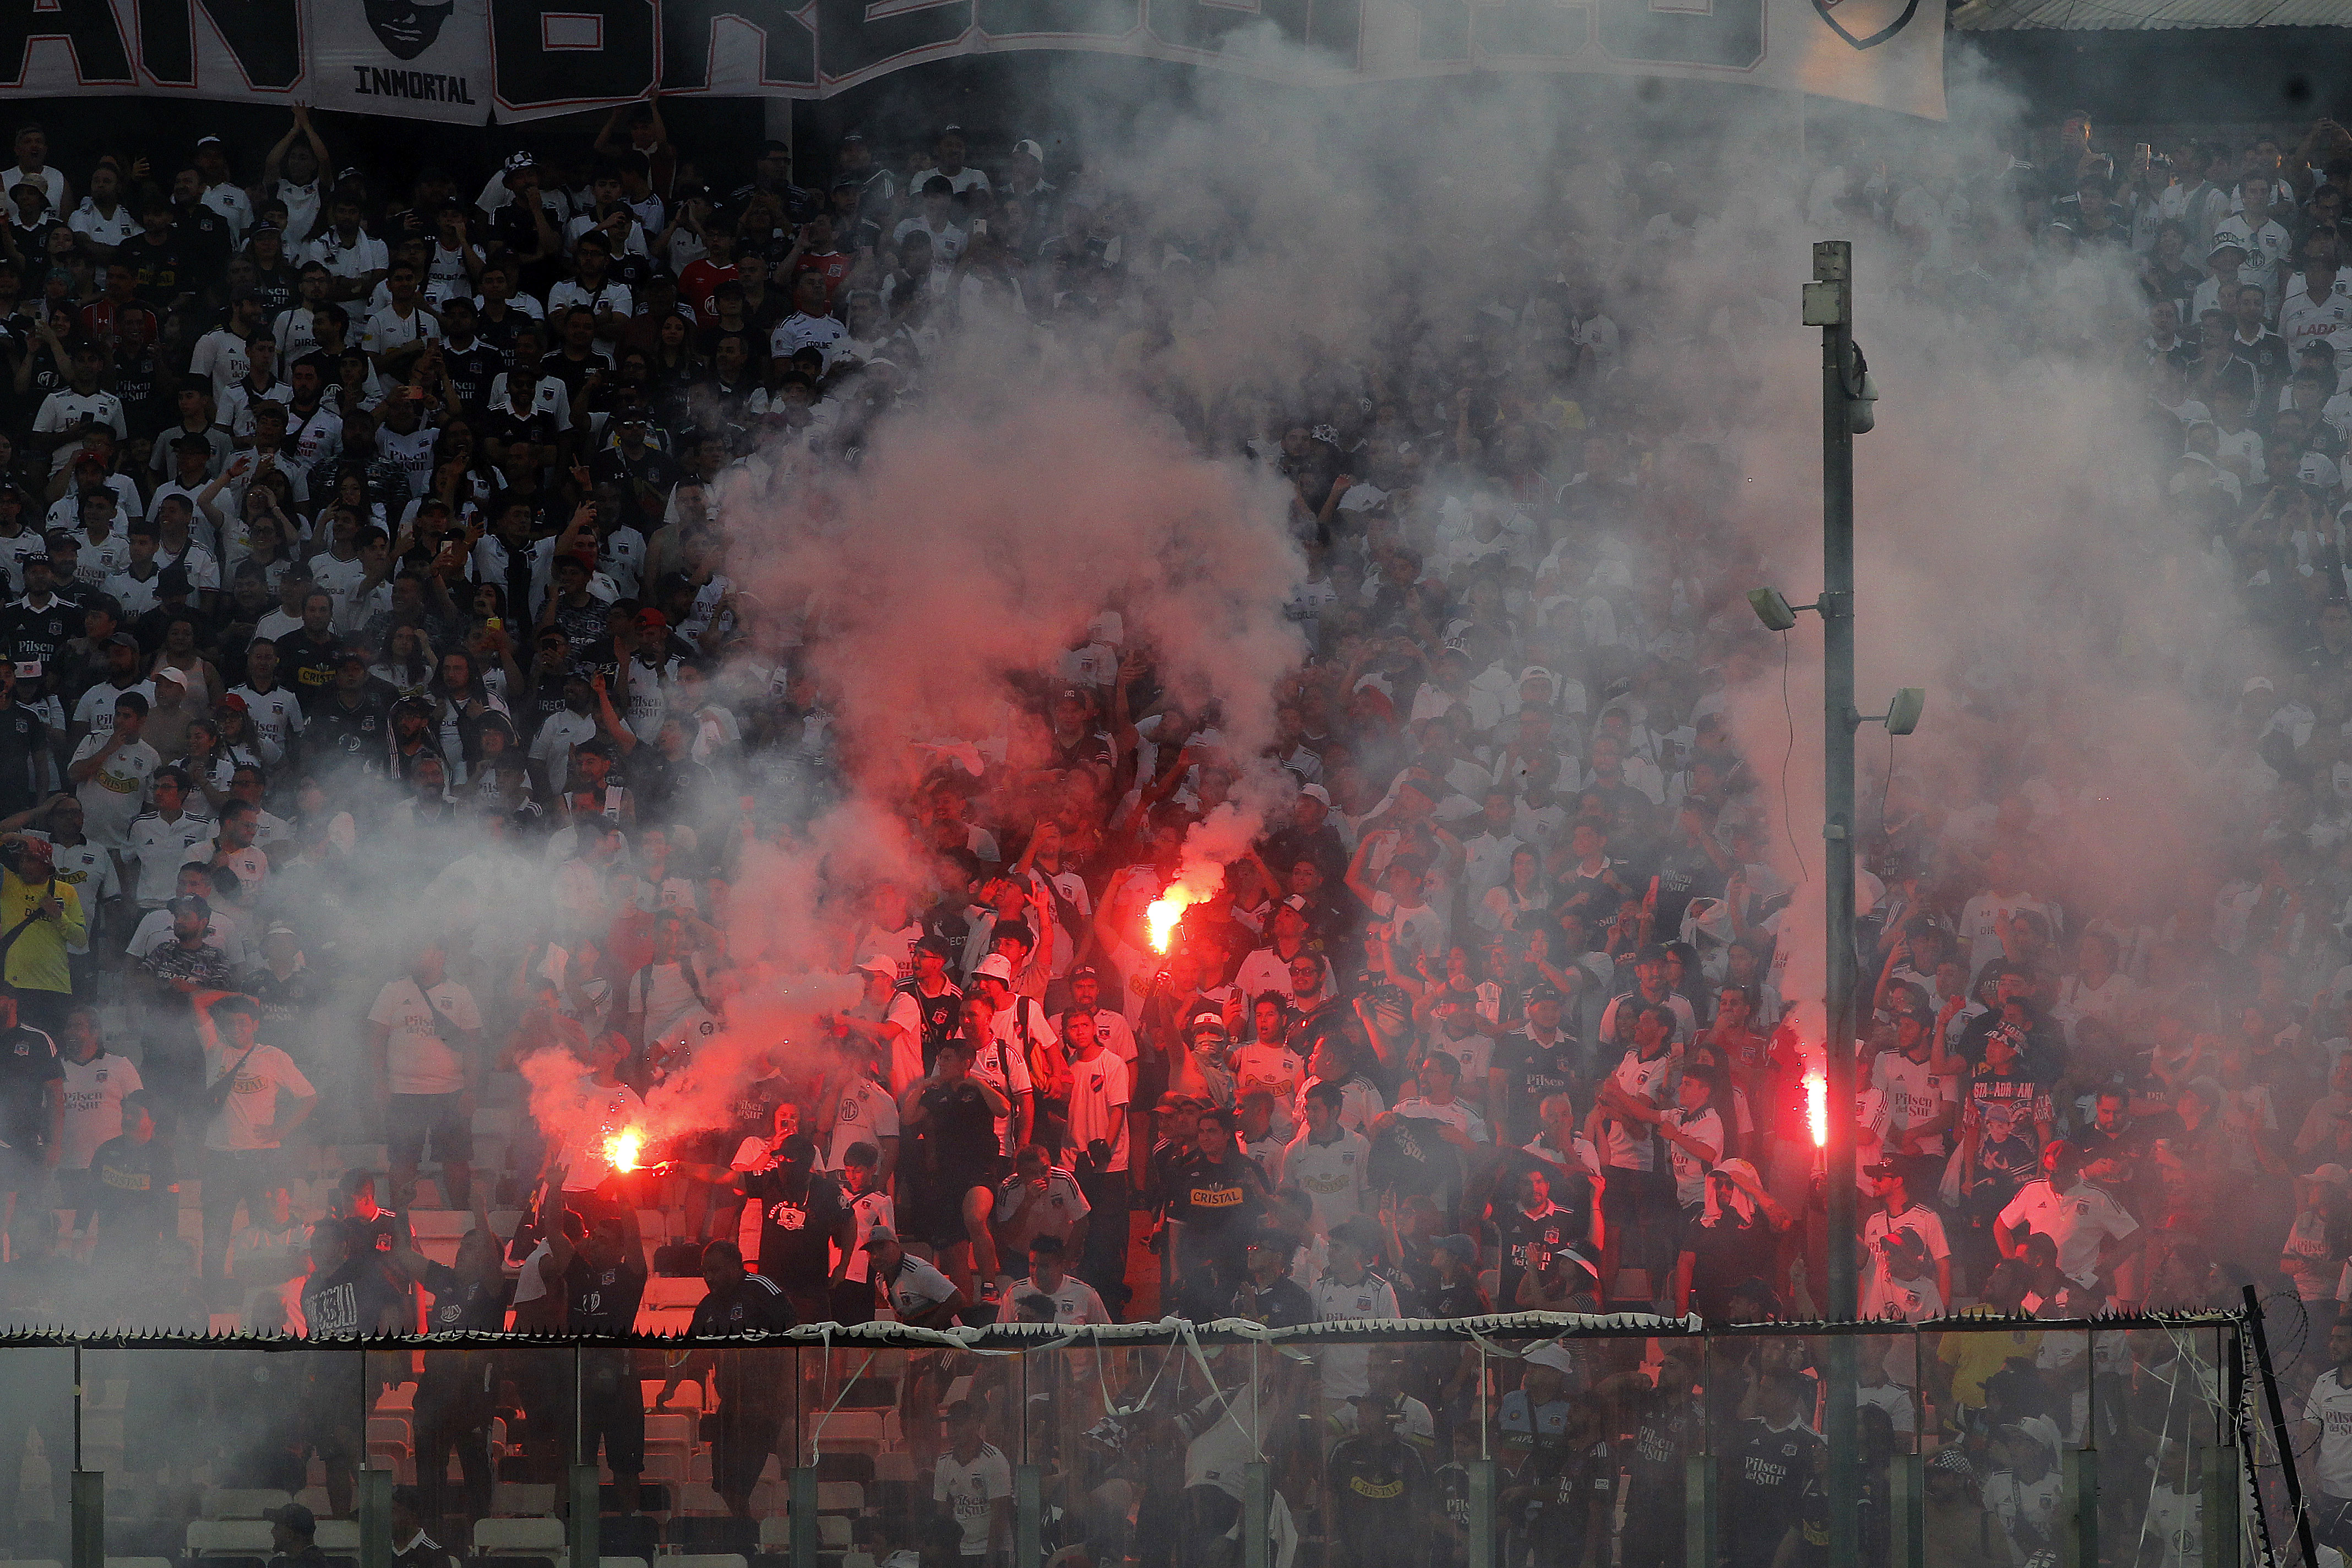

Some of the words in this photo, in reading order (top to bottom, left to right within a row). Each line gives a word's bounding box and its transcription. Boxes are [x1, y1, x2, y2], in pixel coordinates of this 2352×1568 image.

[354, 65, 476, 105] INMORTAL
[2296, 324, 2336, 336] LADA
[19, 640, 55, 653] Pilsen
[96, 714, 112, 724] Pil
[1527, 1075, 1564, 1086] Pilsen
[64, 1092, 103, 1104] Pilsen
[1896, 1093, 1932, 1108] Pilsen
[1908, 1105, 1929, 1118] Sur
[1193, 1191, 1239, 1205] CRISTAL
[769, 1201, 789, 1219] SOMOS
[1638, 1426, 1674, 1452] Pilsen
[1745, 1456, 1788, 1476] Pilsen
[1756, 1471, 1784, 1485] Sur
[1355, 1481, 1399, 1497] CRISTAL
